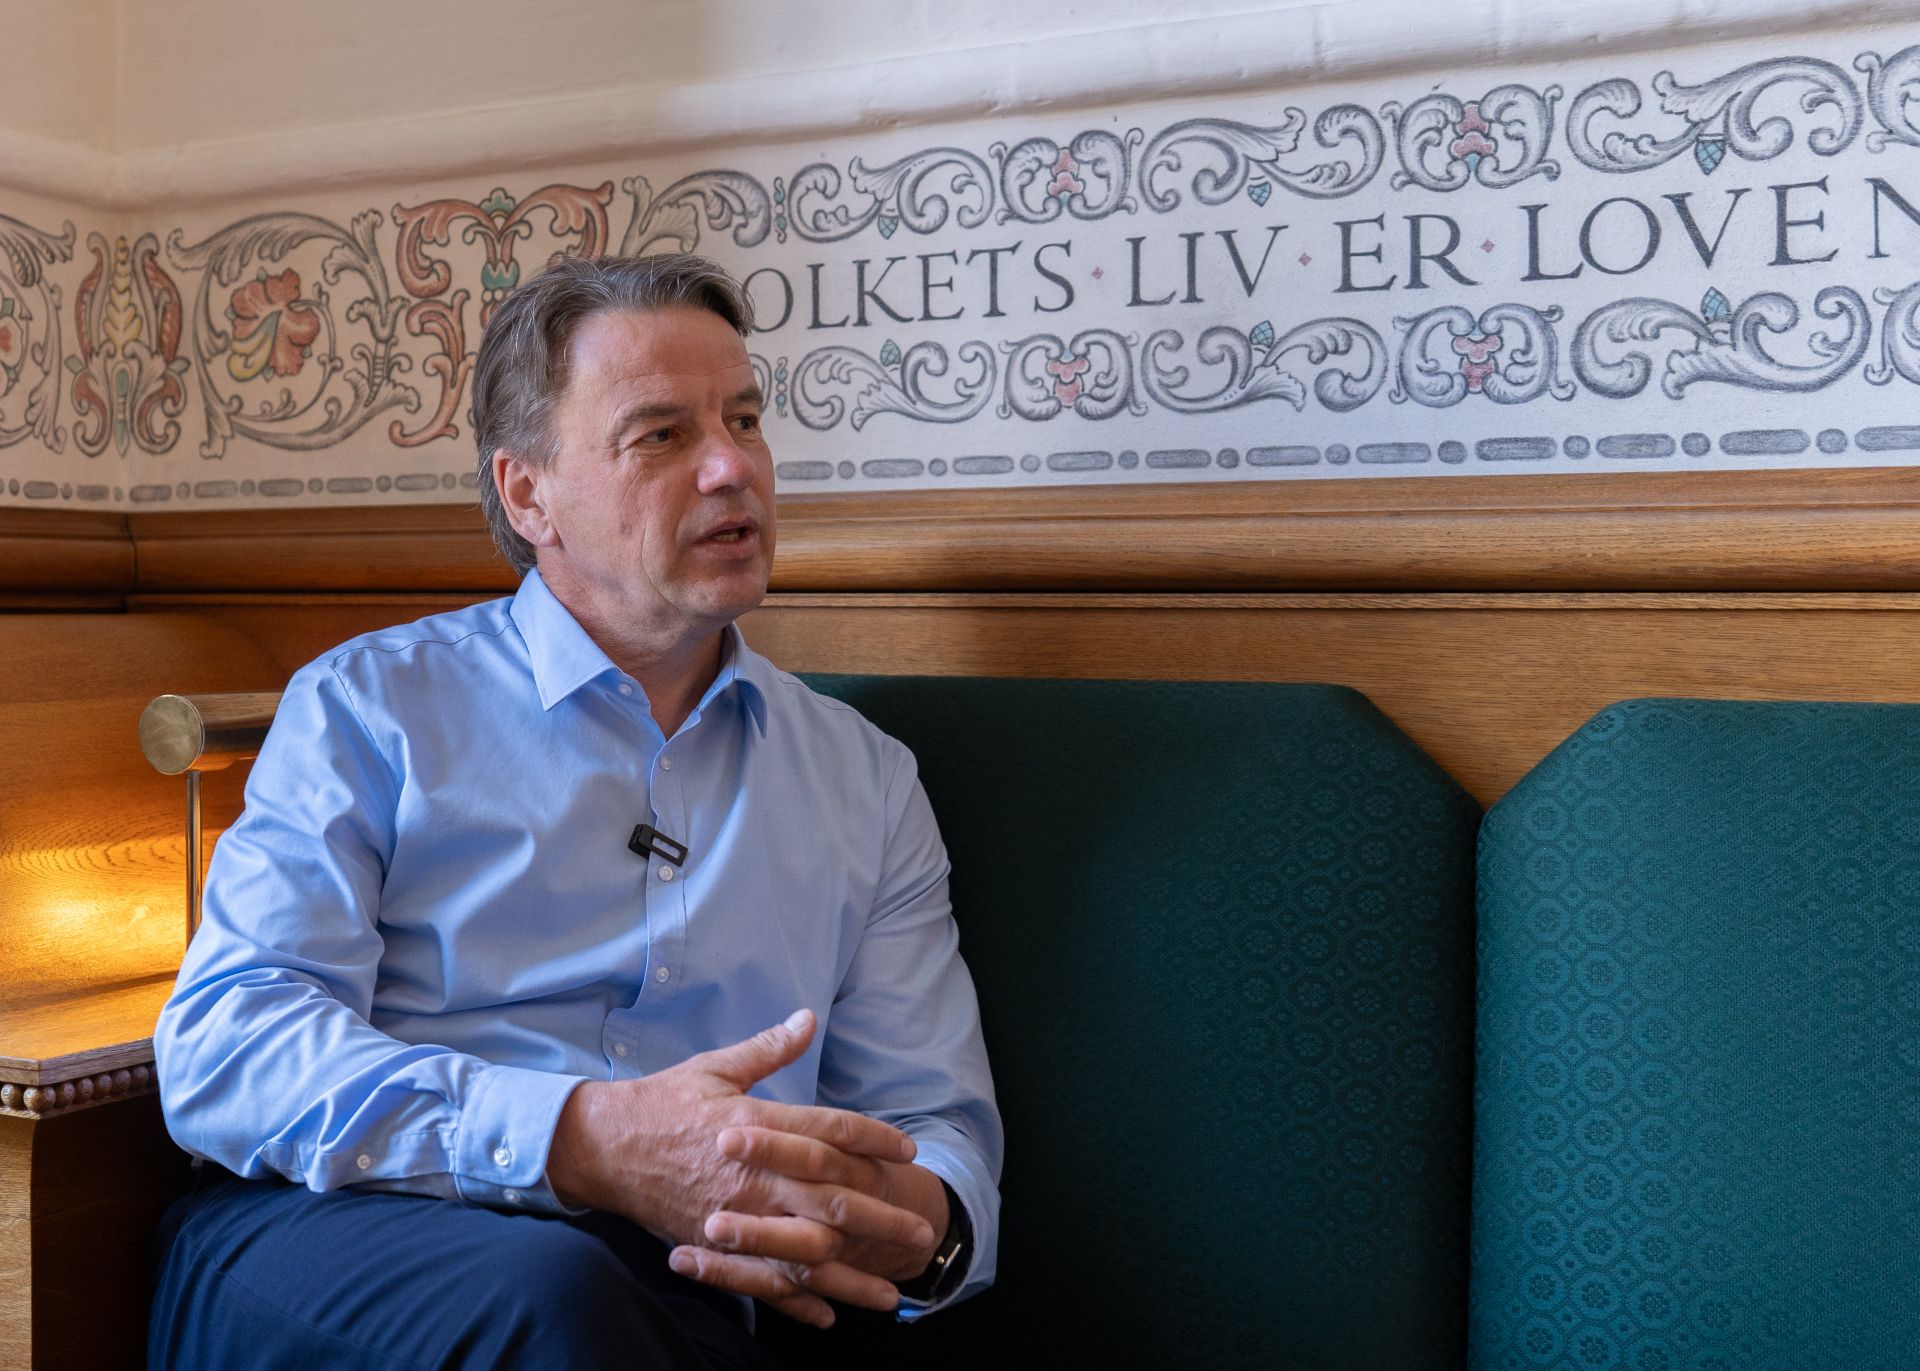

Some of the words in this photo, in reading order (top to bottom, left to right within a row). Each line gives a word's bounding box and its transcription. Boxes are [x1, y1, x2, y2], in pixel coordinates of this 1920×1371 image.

[742, 240, 1075, 333] OLKETS
[1126, 225, 1289, 307] LIV
[1333, 212, 1480, 294] ER
